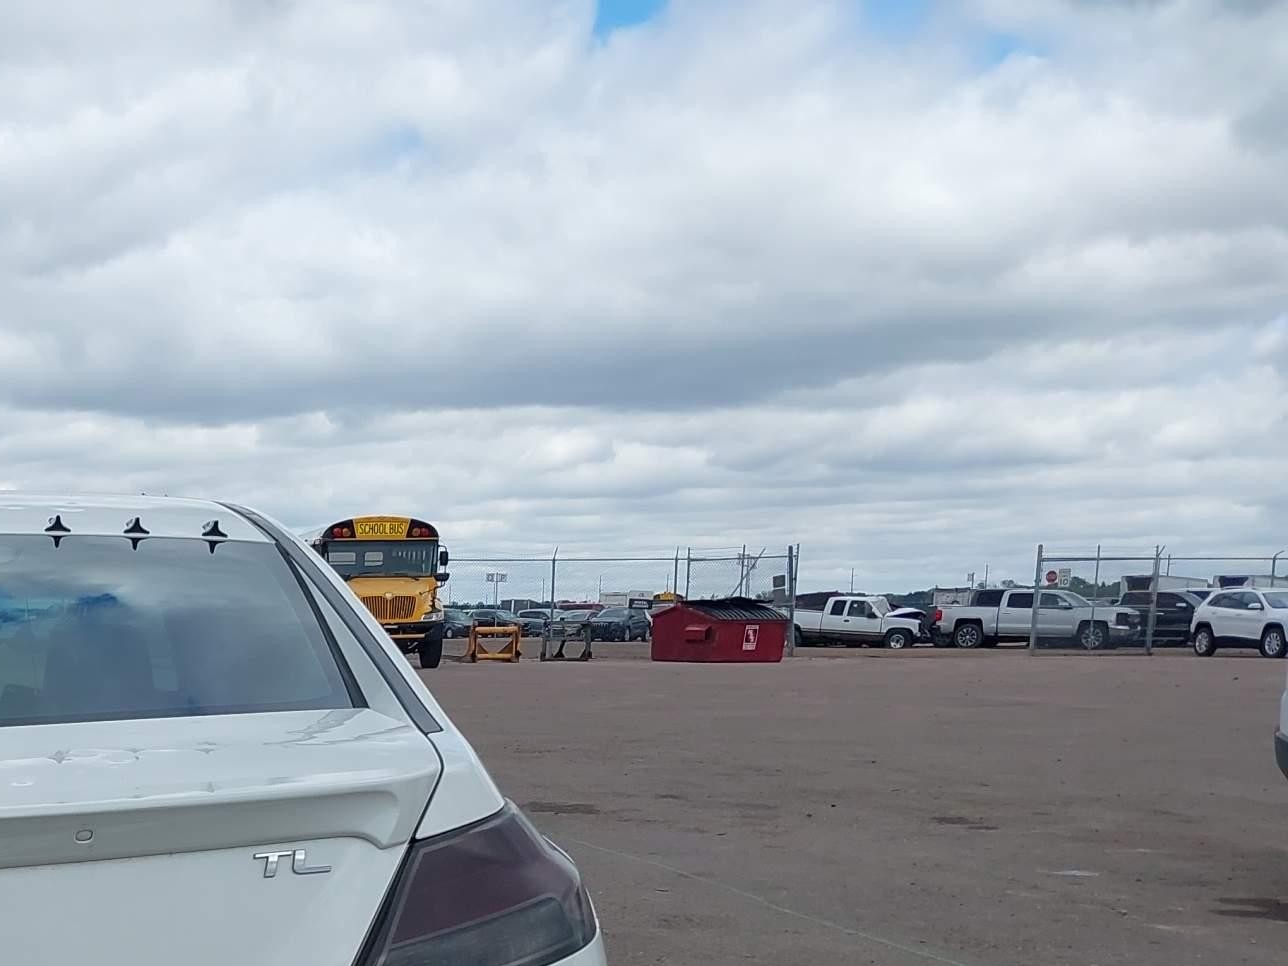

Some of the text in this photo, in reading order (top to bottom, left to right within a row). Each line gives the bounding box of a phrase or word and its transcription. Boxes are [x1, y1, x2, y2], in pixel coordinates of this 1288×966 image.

[359, 523, 404, 535] SCHOOL BUS
[253, 848, 332, 878] TL
